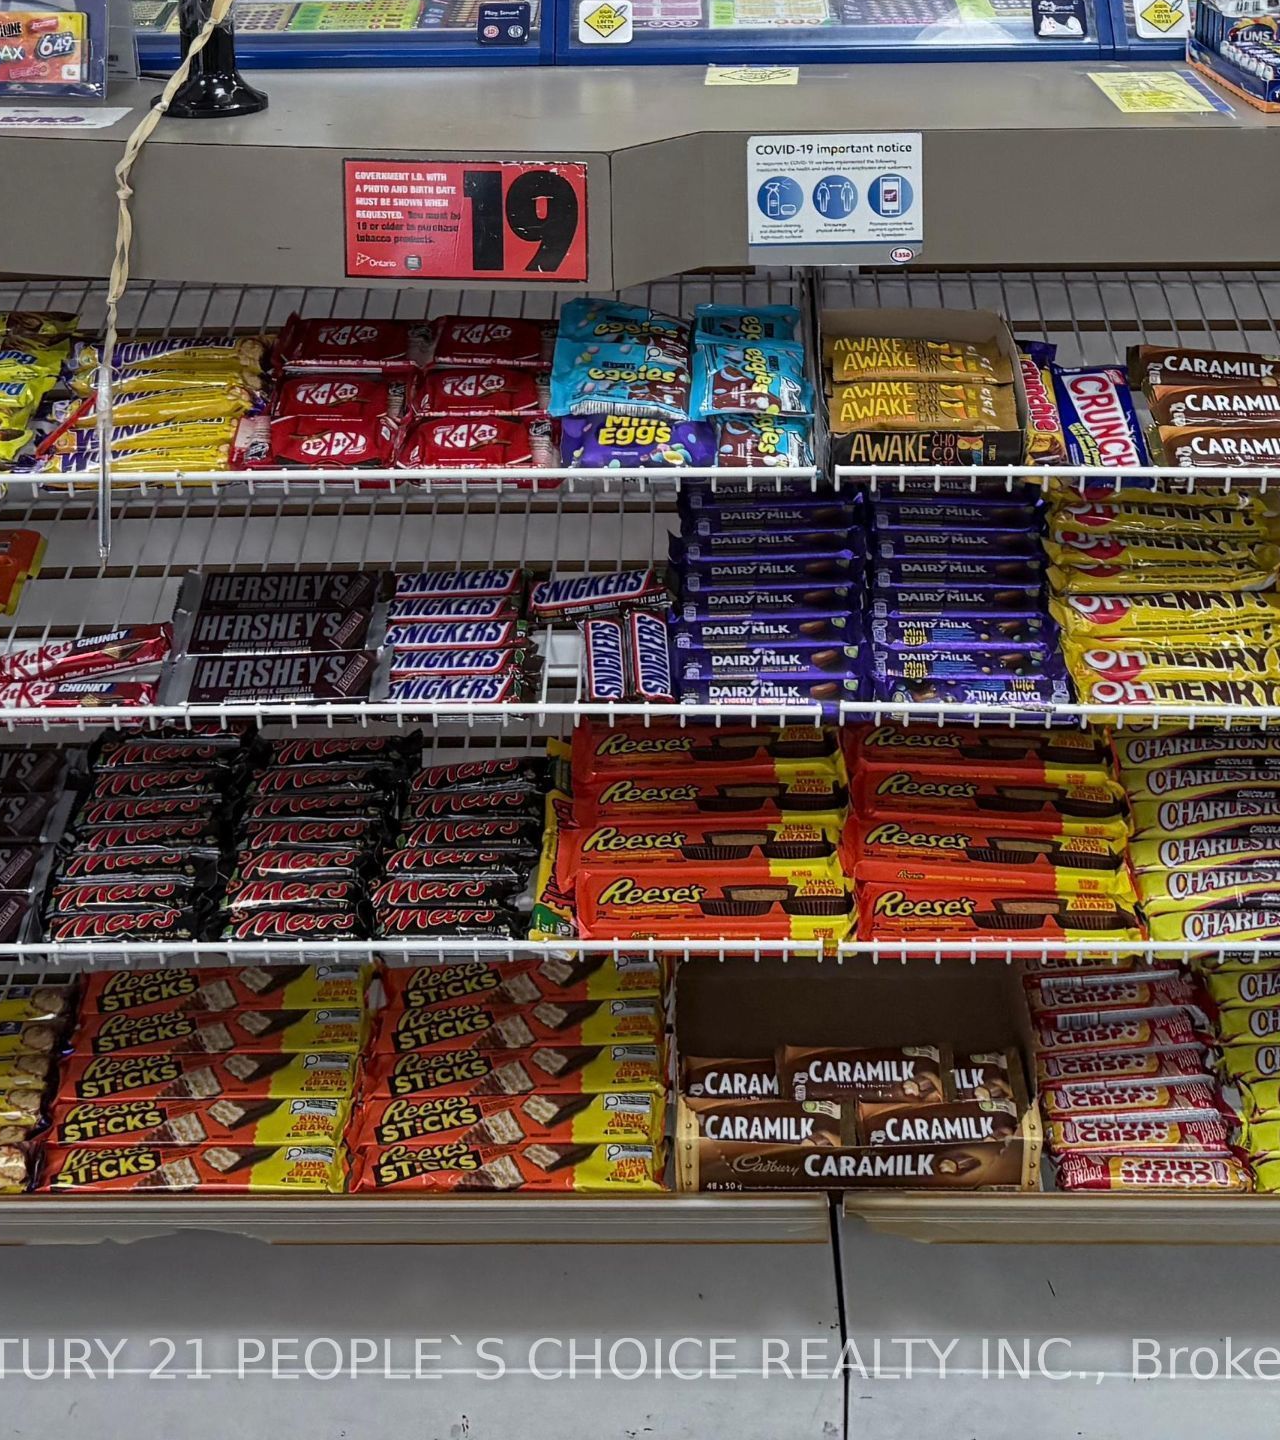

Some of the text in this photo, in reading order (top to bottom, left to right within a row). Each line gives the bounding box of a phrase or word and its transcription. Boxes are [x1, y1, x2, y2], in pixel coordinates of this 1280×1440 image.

[756, 143, 912, 157] COVID-19 important notice
[463, 170, 578, 273] 19
[434, 425, 498, 449] KitKat
[850, 435, 930, 463] AWAKE
[535, 570, 647, 605] SNICKERS
[385, 621, 512, 646] SNICKERS
[199, 656, 347, 688] HERSHEY'S
[58, 682, 112, 694] CHUNKY
[710, 685, 800, 698] DAIRY MILK
[599, 880, 704, 908] Reese's
[235, 910, 355, 938] Mars
[808, 1060, 916, 1083] CARAMILK
[732, 1154, 934, 1177] Cadbury CARAMILK
